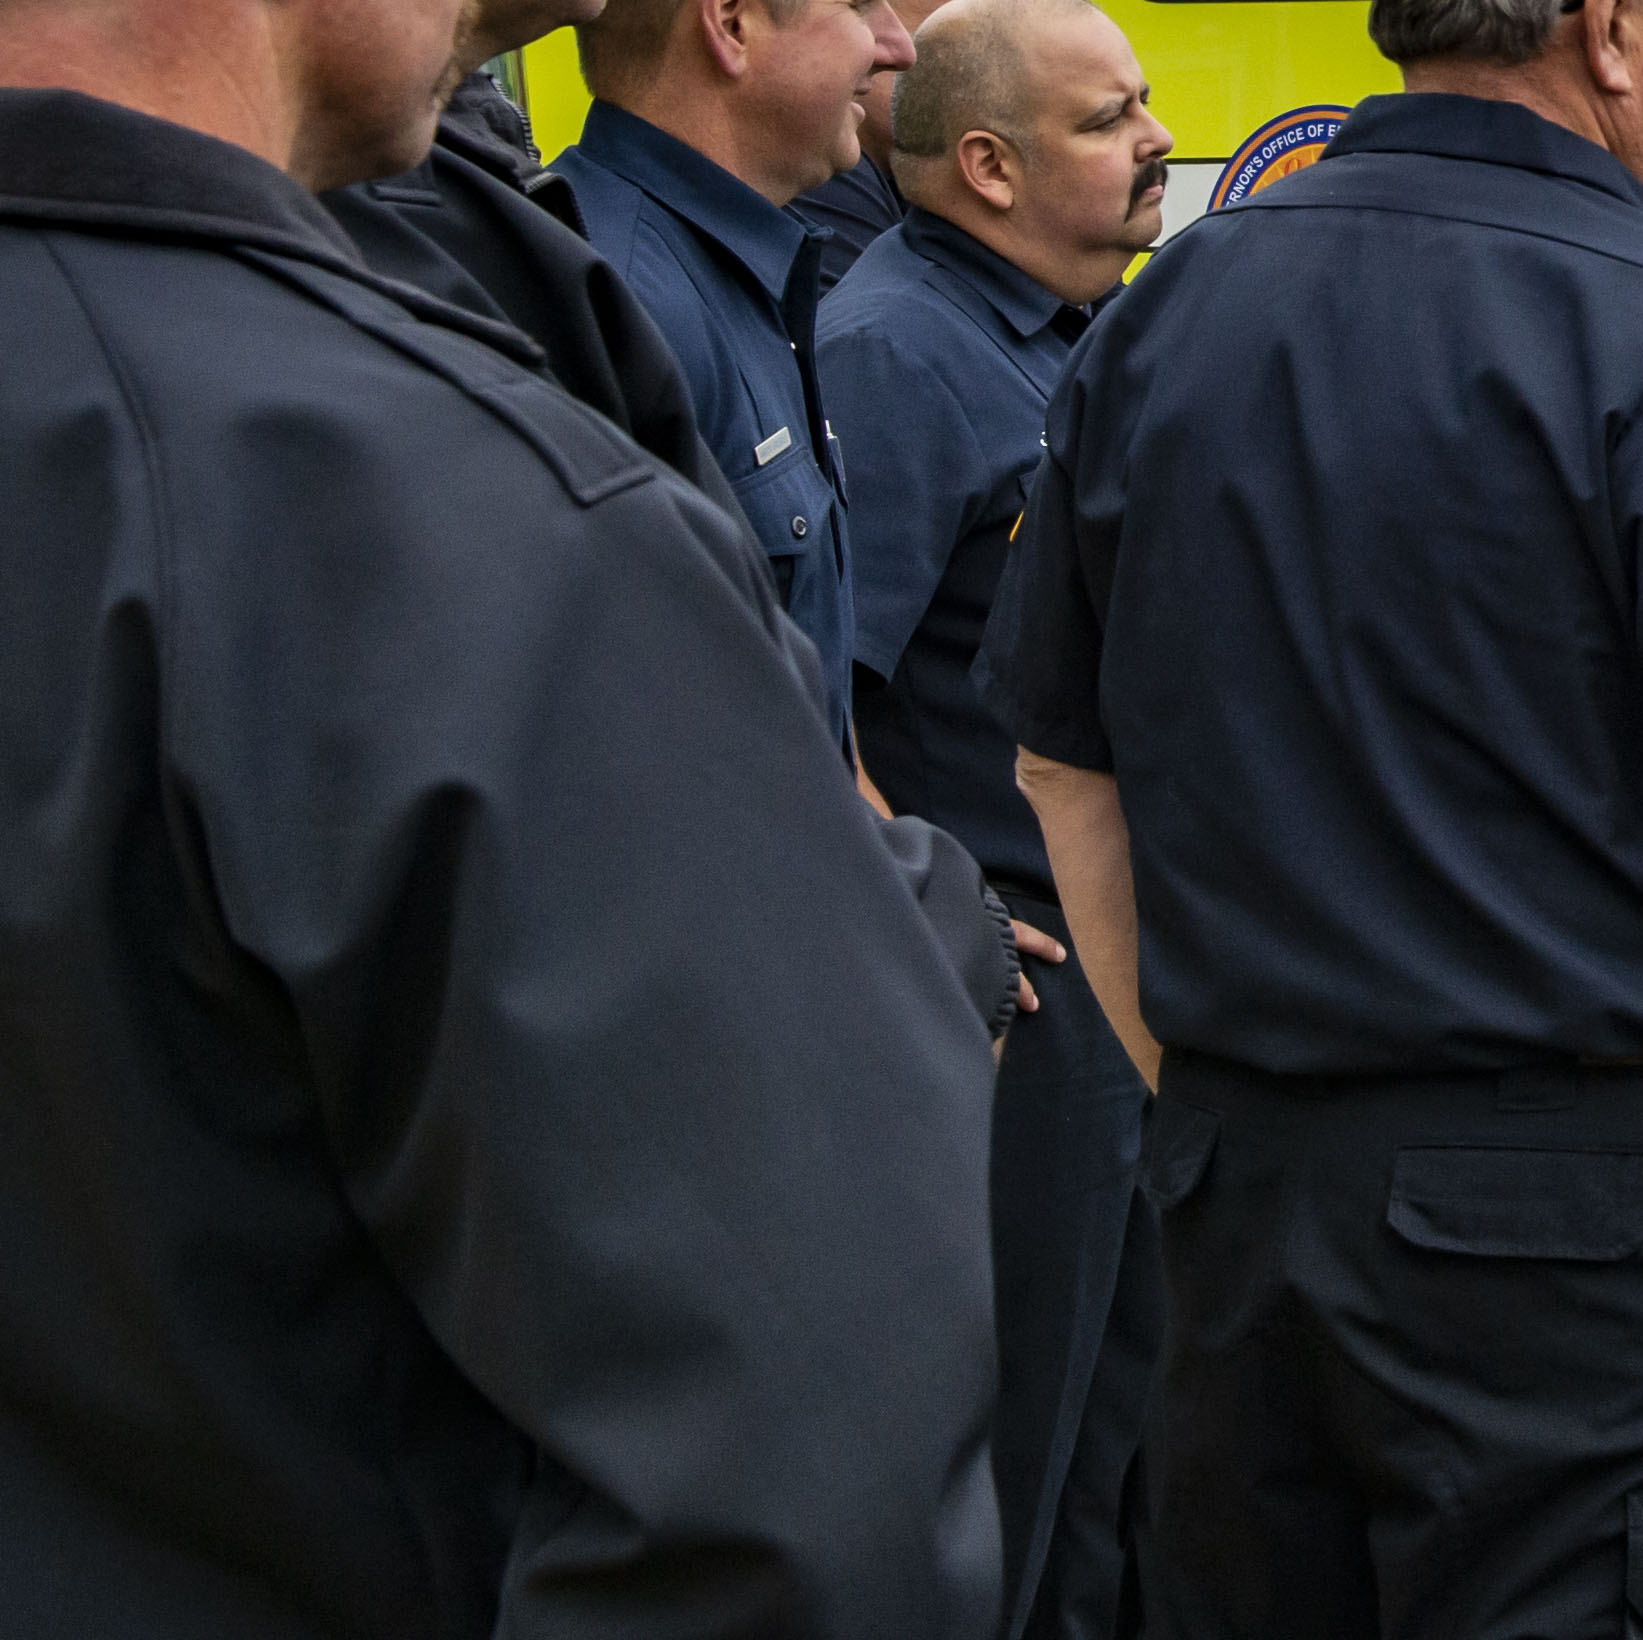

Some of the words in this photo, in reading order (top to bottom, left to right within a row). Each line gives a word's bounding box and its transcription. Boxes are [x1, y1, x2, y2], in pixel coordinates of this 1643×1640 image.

[1226, 156, 1264, 206] RNOR'S
[1262, 127, 1305, 159] OFFICE
[1307, 124, 1324, 138] OF
